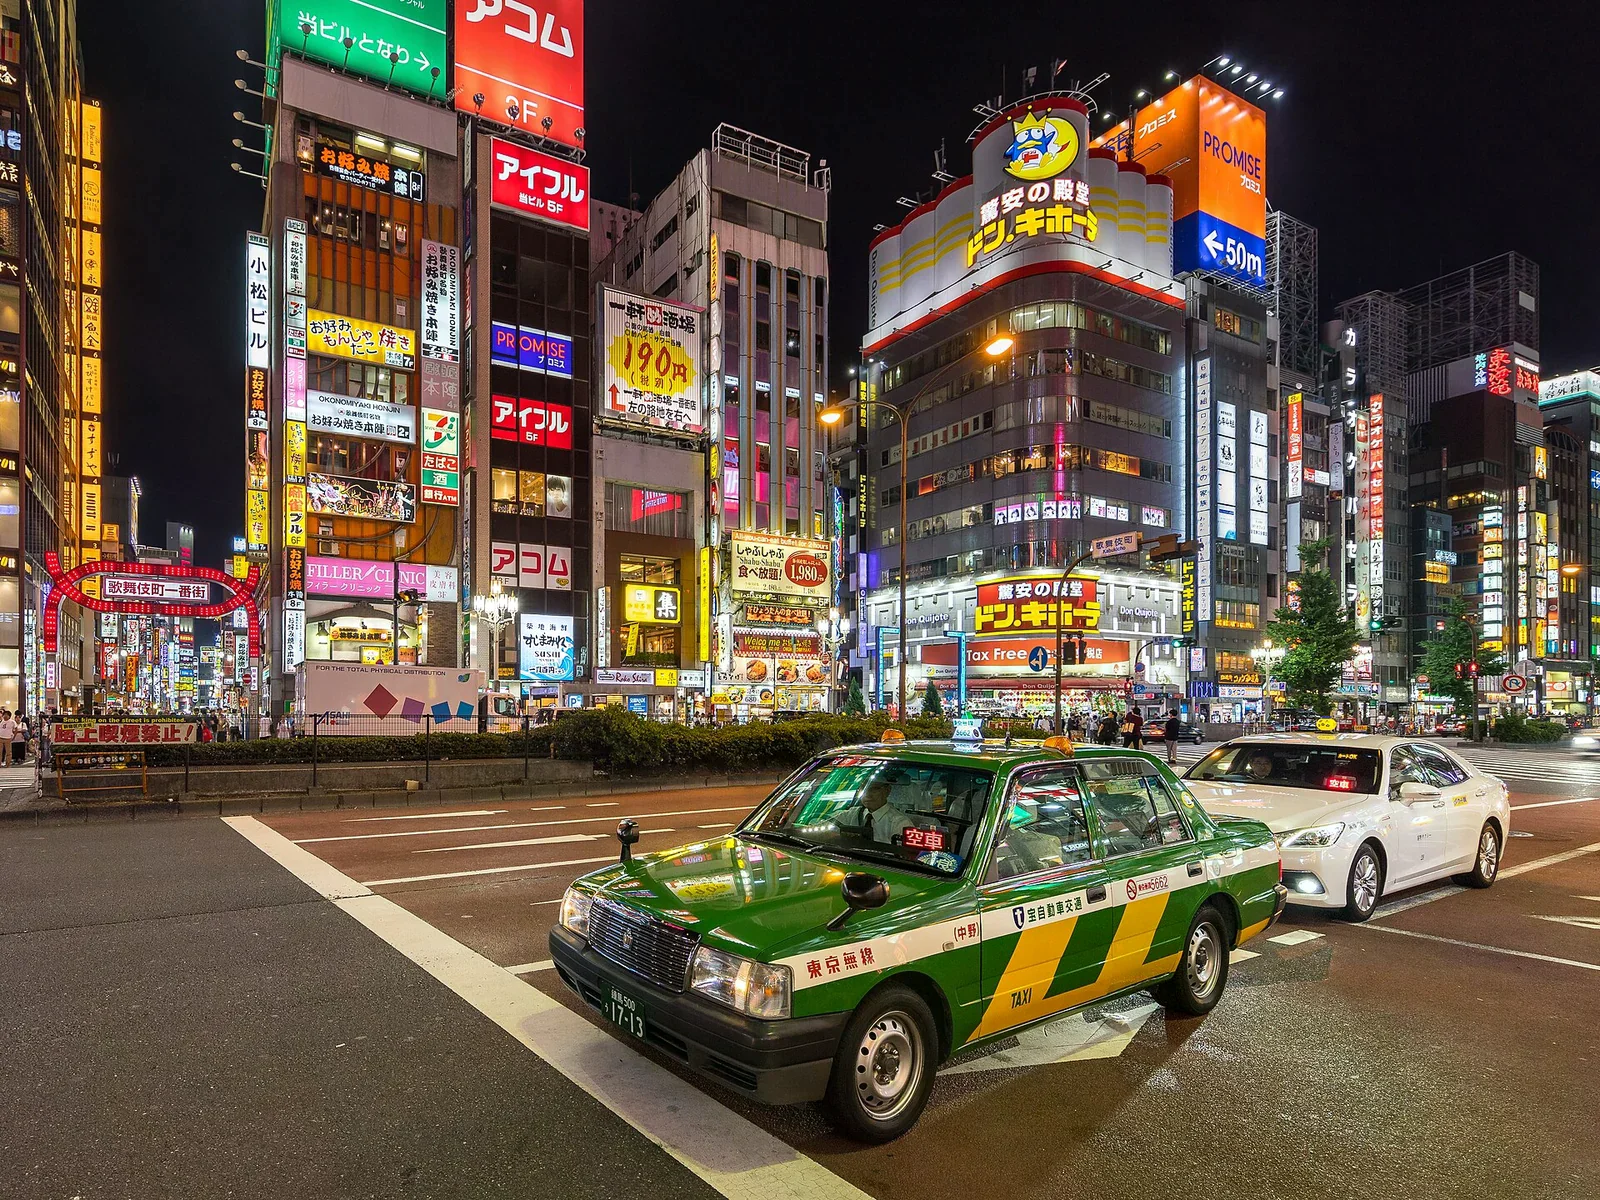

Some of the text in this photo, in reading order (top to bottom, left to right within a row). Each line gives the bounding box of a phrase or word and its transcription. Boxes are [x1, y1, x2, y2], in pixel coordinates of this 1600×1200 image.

[297, 11, 410, 64] 当ビルとなり
[1138, 108, 1177, 139] プロミス
[320, 147, 390, 181] お好み焼
[1203, 131, 1261, 180] PROMISE
[496, 152, 584, 203] アイフル
[1240, 174, 1261, 195] プロミス
[519, 193, 563, 213] 当ビル 5F
[980, 179, 1090, 226] 驚安の殿堂
[1226, 237, 1262, 277] 50m
[250, 257, 267, 349] 小松ビル
[426, 254, 439, 342] お好み焼き本陣
[310, 319, 351, 334] お好み
[323, 329, 373, 347] もんじゃ
[351, 342, 377, 355] たこ
[379, 329, 410, 350] 焼き
[497, 331, 565, 358] PROMISE
[403, 356, 413, 367] 7F
[538, 355, 565, 368] プロミス
[624, 338, 687, 383] 190円
[252, 369, 265, 410] お好み焼
[423, 377, 457, 399] 本陣
[318, 396, 401, 413] OKONOMIYAKI HONJIN
[628, 401, 692, 422] 左の路地を右へ
[252, 418, 263, 427] 8F
[311, 414, 385, 434] お好み焼き本陣
[494, 400, 569, 433] アイフル
[526, 431, 538, 441] 5F
[424, 456, 457, 471] たばこ
[433, 473, 447, 485] 酒
[291, 536, 301, 544] 6F
[736, 544, 785, 559] しゃぶしゃぶ
[290, 549, 302, 590] お好み焼
[493, 549, 569, 577] アコム
[307, 564, 425, 585] FILLER CLNIC
[108, 580, 206, 599] 歌舞伎町一番街
[997, 581, 1083, 601] 驚安の殿堂
[656, 592, 677, 618] 集
[1120, 605, 1159, 618] Don Quijote
[919, 612, 949, 625] Quijote
[966, 648, 1027, 661] Tax Free
[54, 724, 195, 743] 路上喫煙禁止!
[905, 829, 943, 850] 空車
[1150, 875, 1169, 891] 5662
[1027, 897, 1083, 923] 宝自動車交通
[953, 921, 979, 943] (中野)
[806, 947, 875, 979] 東京無線
[623, 995, 635, 1012] 500
[1011, 988, 1033, 1009] TAXI
